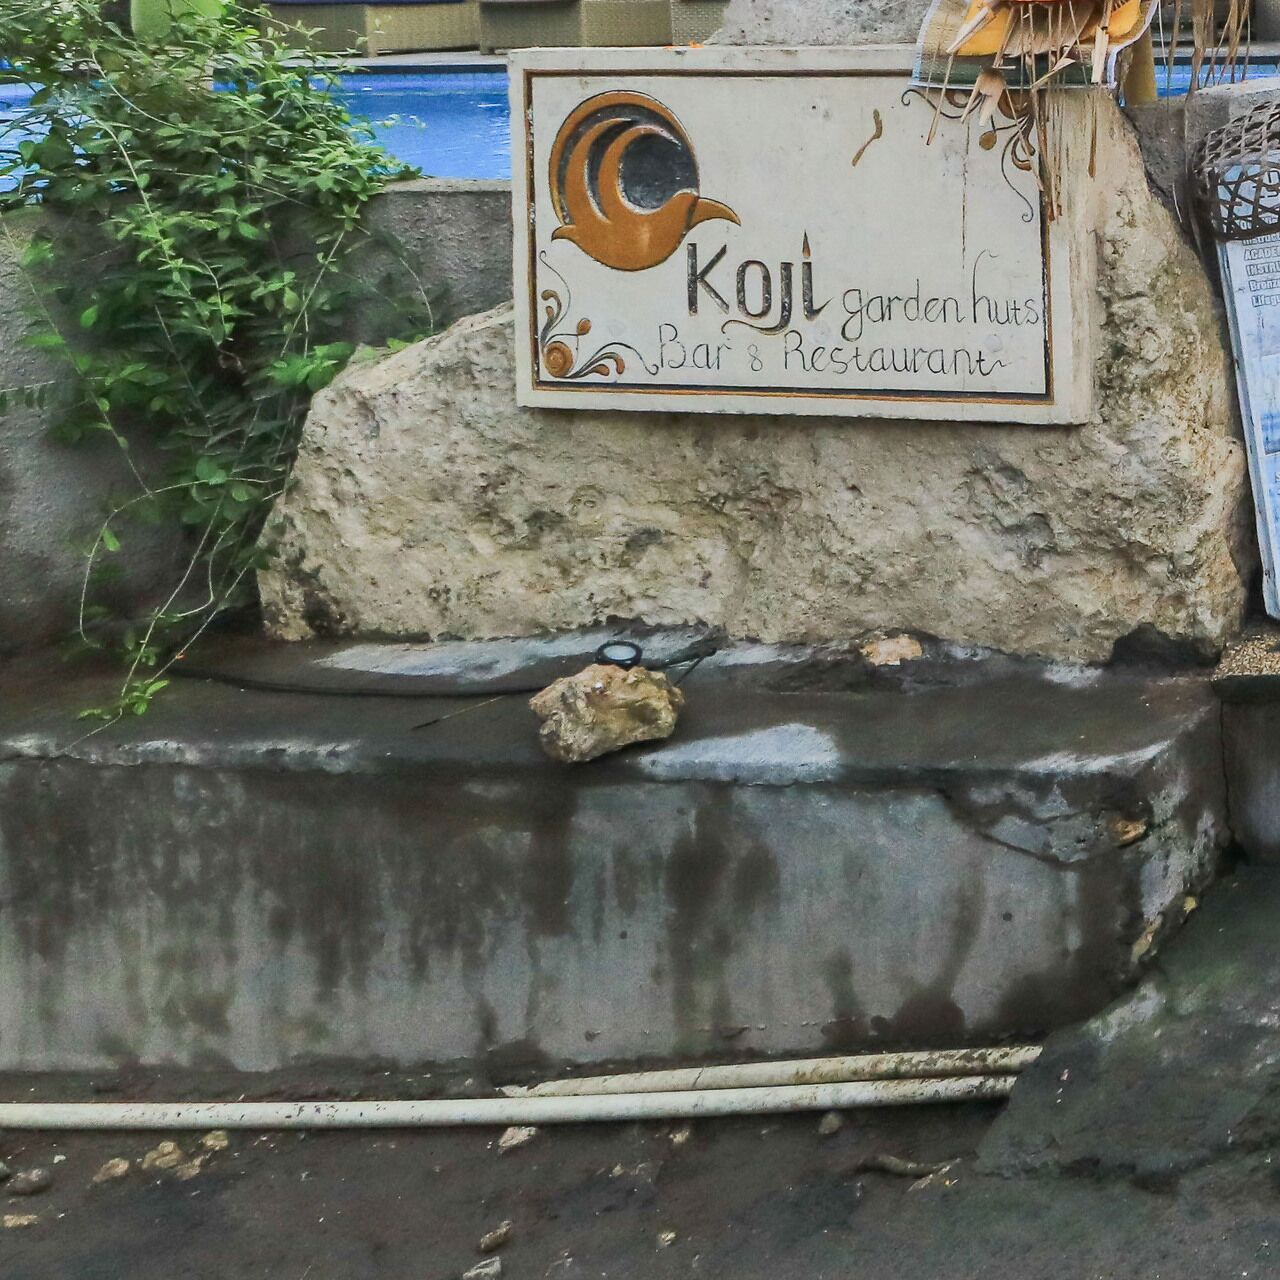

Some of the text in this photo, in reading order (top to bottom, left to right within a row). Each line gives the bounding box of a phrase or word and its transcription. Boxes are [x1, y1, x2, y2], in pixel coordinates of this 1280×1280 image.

[686, 230, 1040, 342] Koji garden huts
[659, 323, 732, 371] Bar
[784, 329, 1007, 376] Restaurant
